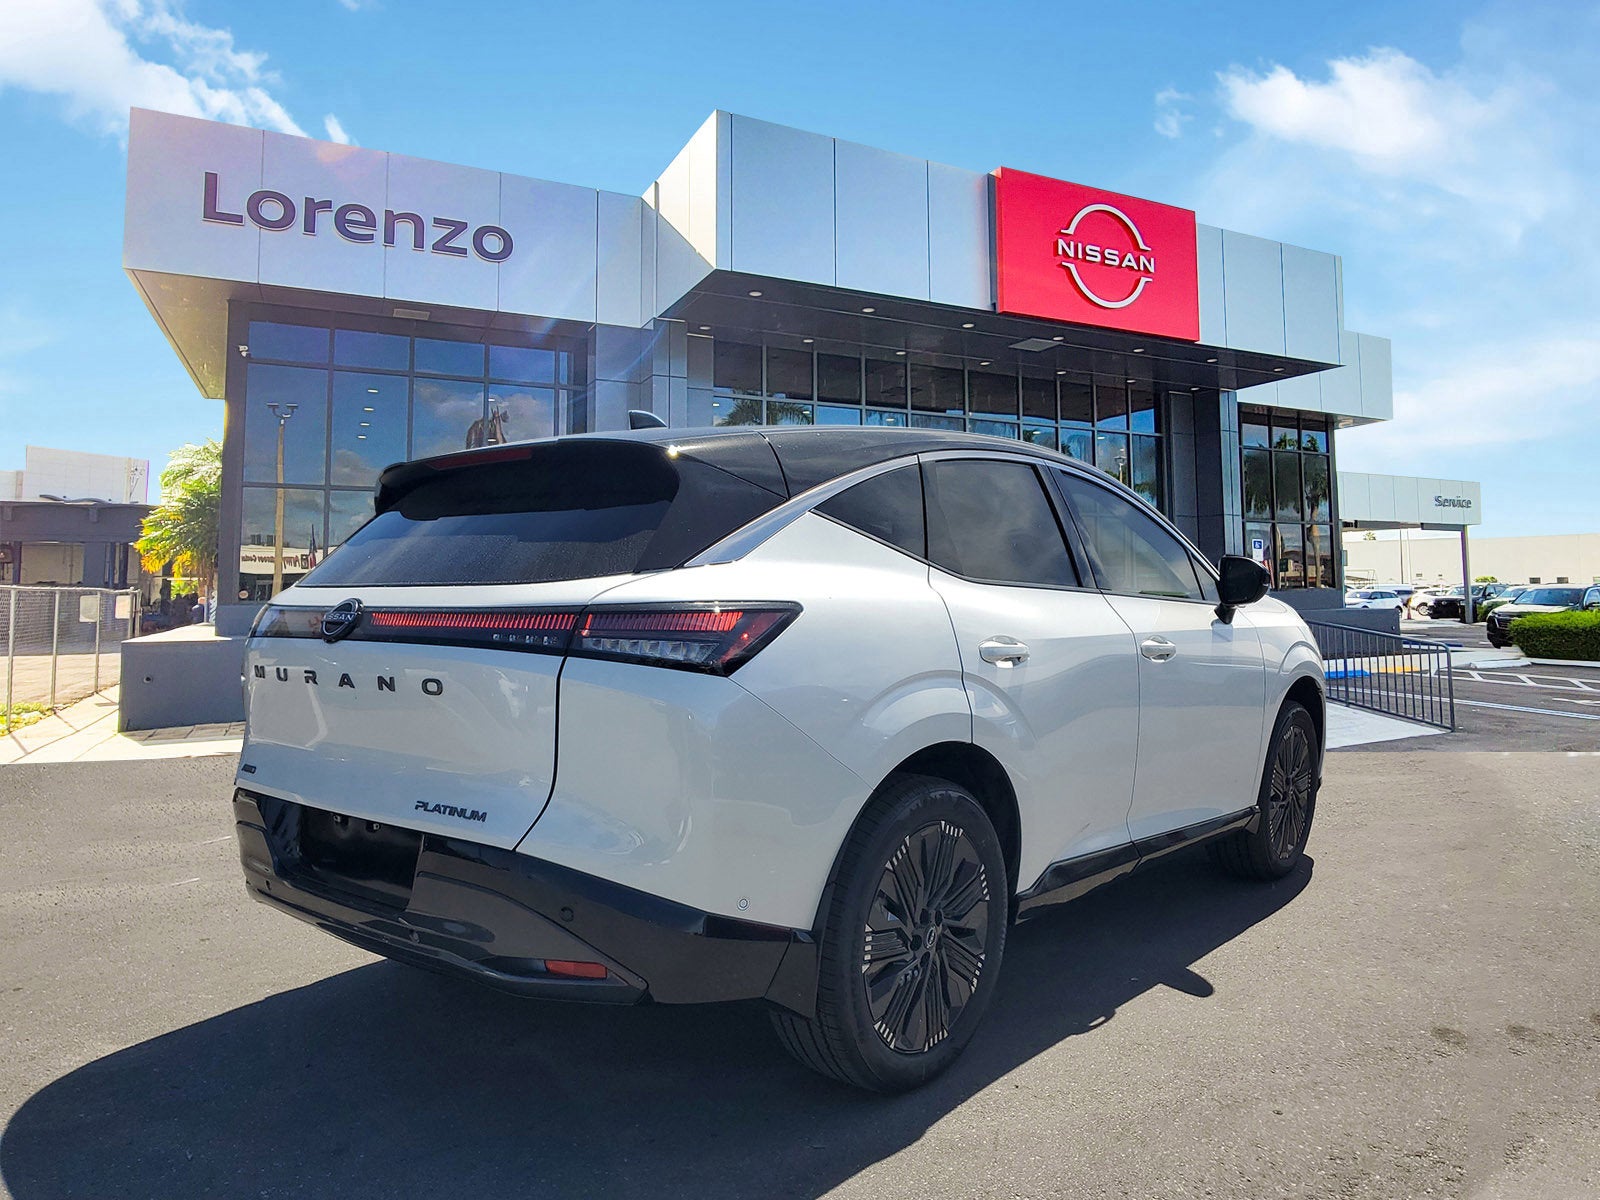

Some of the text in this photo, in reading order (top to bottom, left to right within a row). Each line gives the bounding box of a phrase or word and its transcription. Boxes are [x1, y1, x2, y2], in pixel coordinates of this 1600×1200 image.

[202, 171, 514, 262] Lorenzo
[1057, 238, 1155, 273] NISSAN
[1434, 495, 1472, 509] Service
[254, 664, 444, 696] MURANO
[414, 800, 488, 823] PLATINUM
